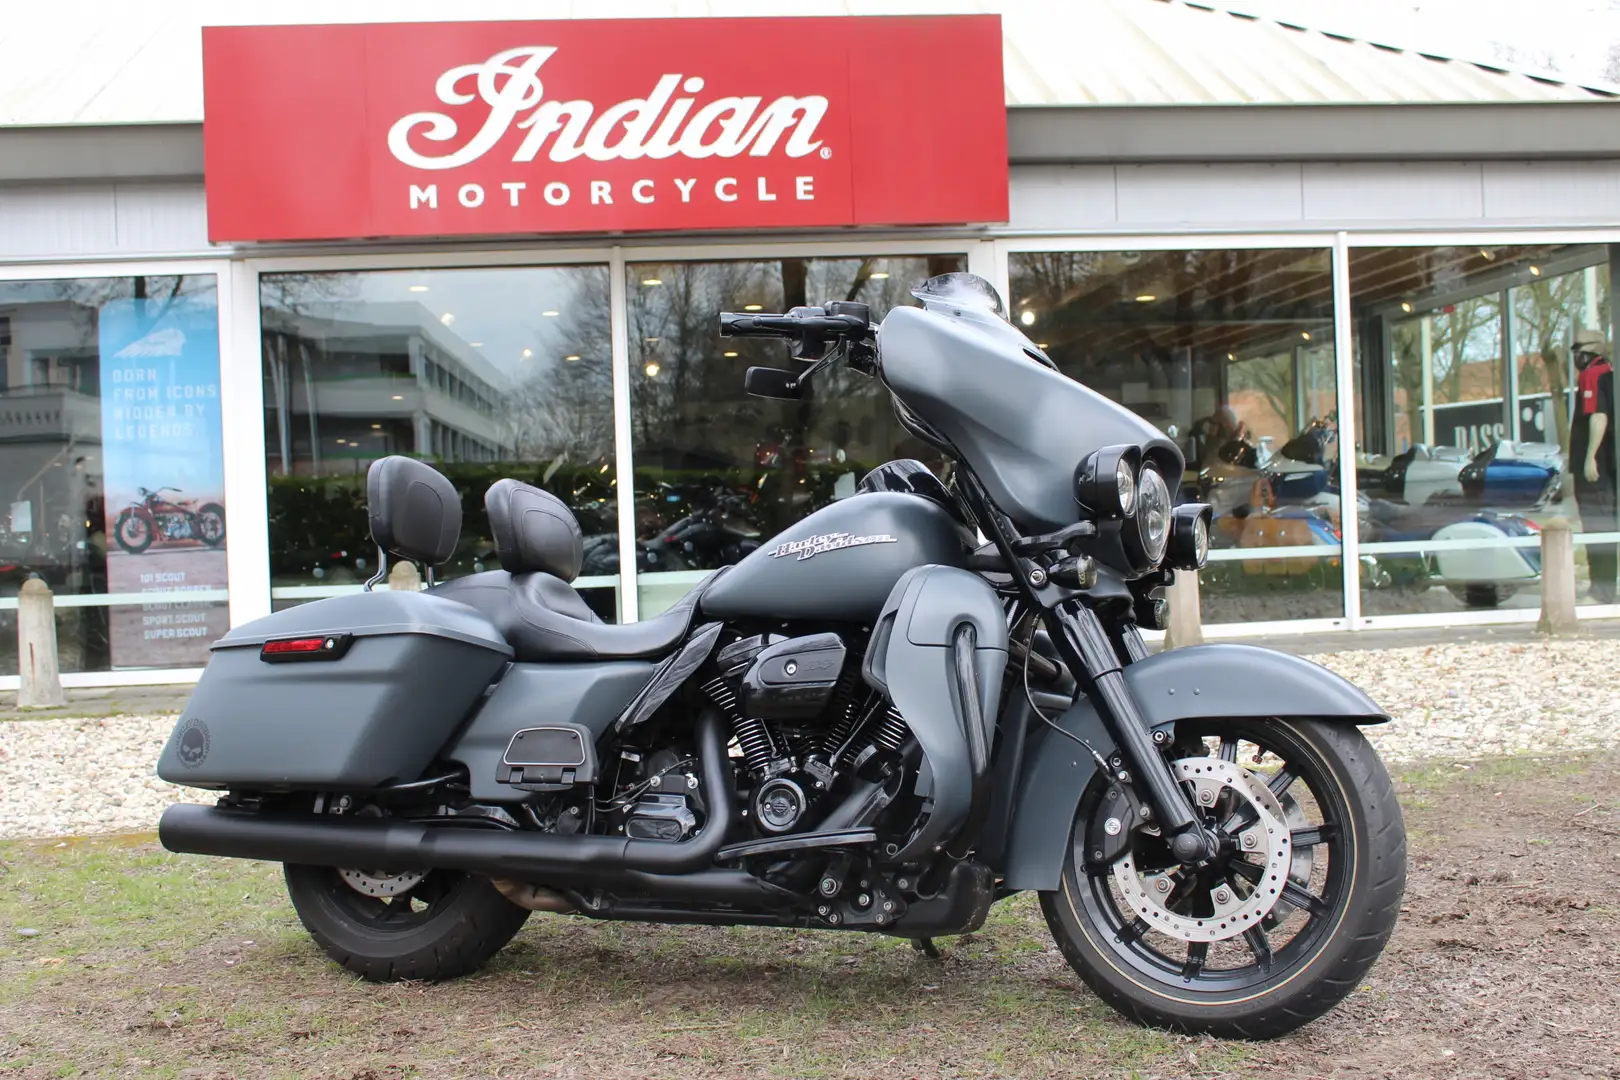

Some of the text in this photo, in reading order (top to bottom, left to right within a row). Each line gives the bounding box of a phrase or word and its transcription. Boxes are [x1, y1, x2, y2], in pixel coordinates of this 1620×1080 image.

[388, 46, 829, 169] Indian
[409, 177, 816, 209] MOTORCYCLE
[113, 384, 217, 402] FROM ICONS
[184, 403, 205, 419] BY
[155, 572, 186, 583] SCOUT
[142, 613, 207, 626] SPORT SCOUT
[143, 626, 208, 640] SUPER SCOUT
